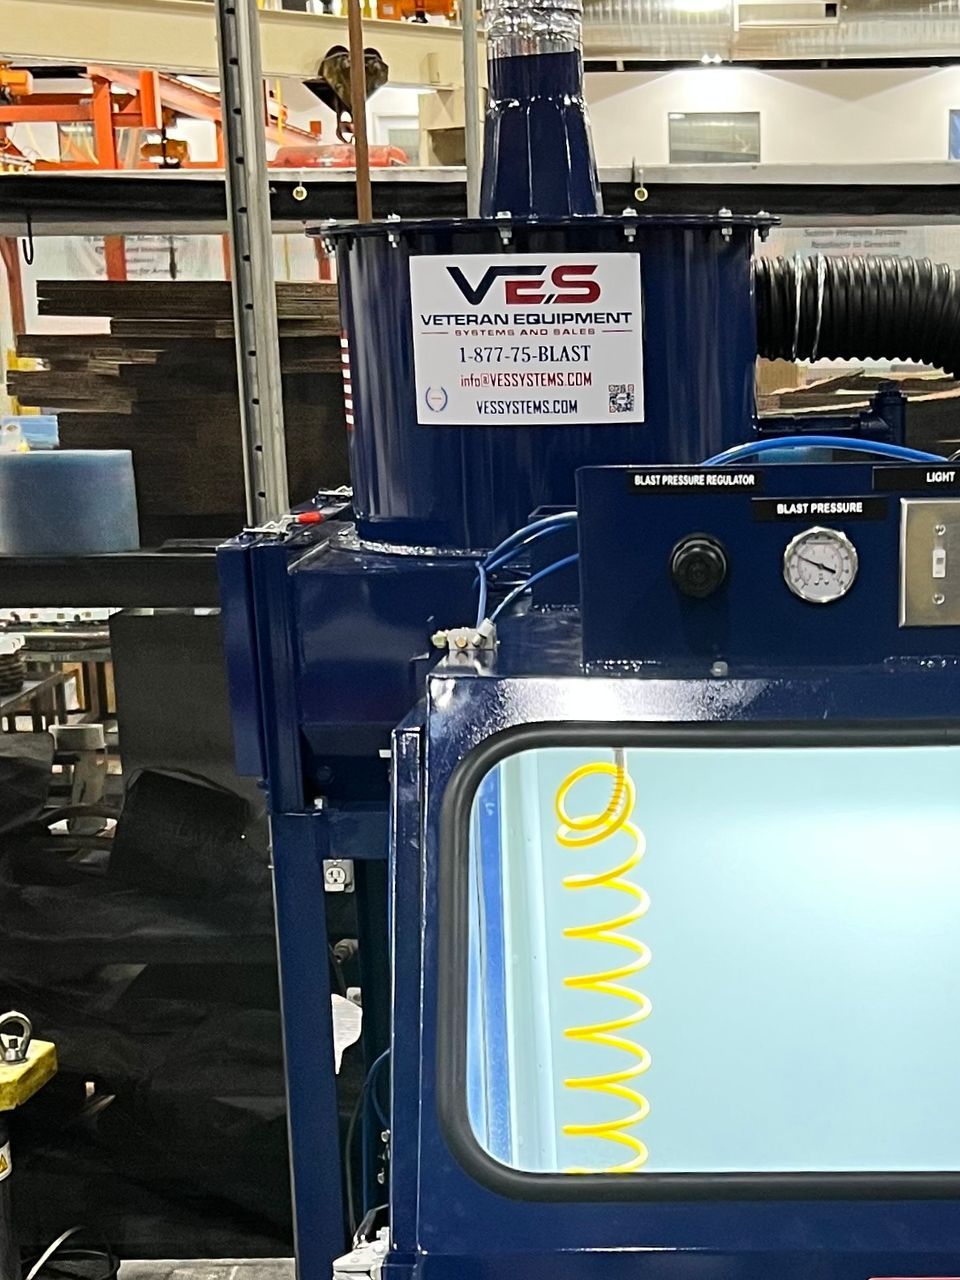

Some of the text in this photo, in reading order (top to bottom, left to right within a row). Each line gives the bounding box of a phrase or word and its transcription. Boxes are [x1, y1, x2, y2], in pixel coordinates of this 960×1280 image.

[446, 265, 601, 306] VES
[421, 312, 632, 326] VETERAN EQUIPMENT
[455, 328, 596, 336] SYSTEMS AND SALES
[459, 345, 592, 363] 1-877-75-BLAST
[460, 372, 592, 388] info@VESSYSTEMS.COM
[476, 400, 578, 415] VESSYSTEMS.COM
[634, 474, 755, 486] BLAST PRESSURE REGULATOR
[926, 471, 956, 483] LIGHT
[776, 502, 863, 514] BLAST PRESSURE
